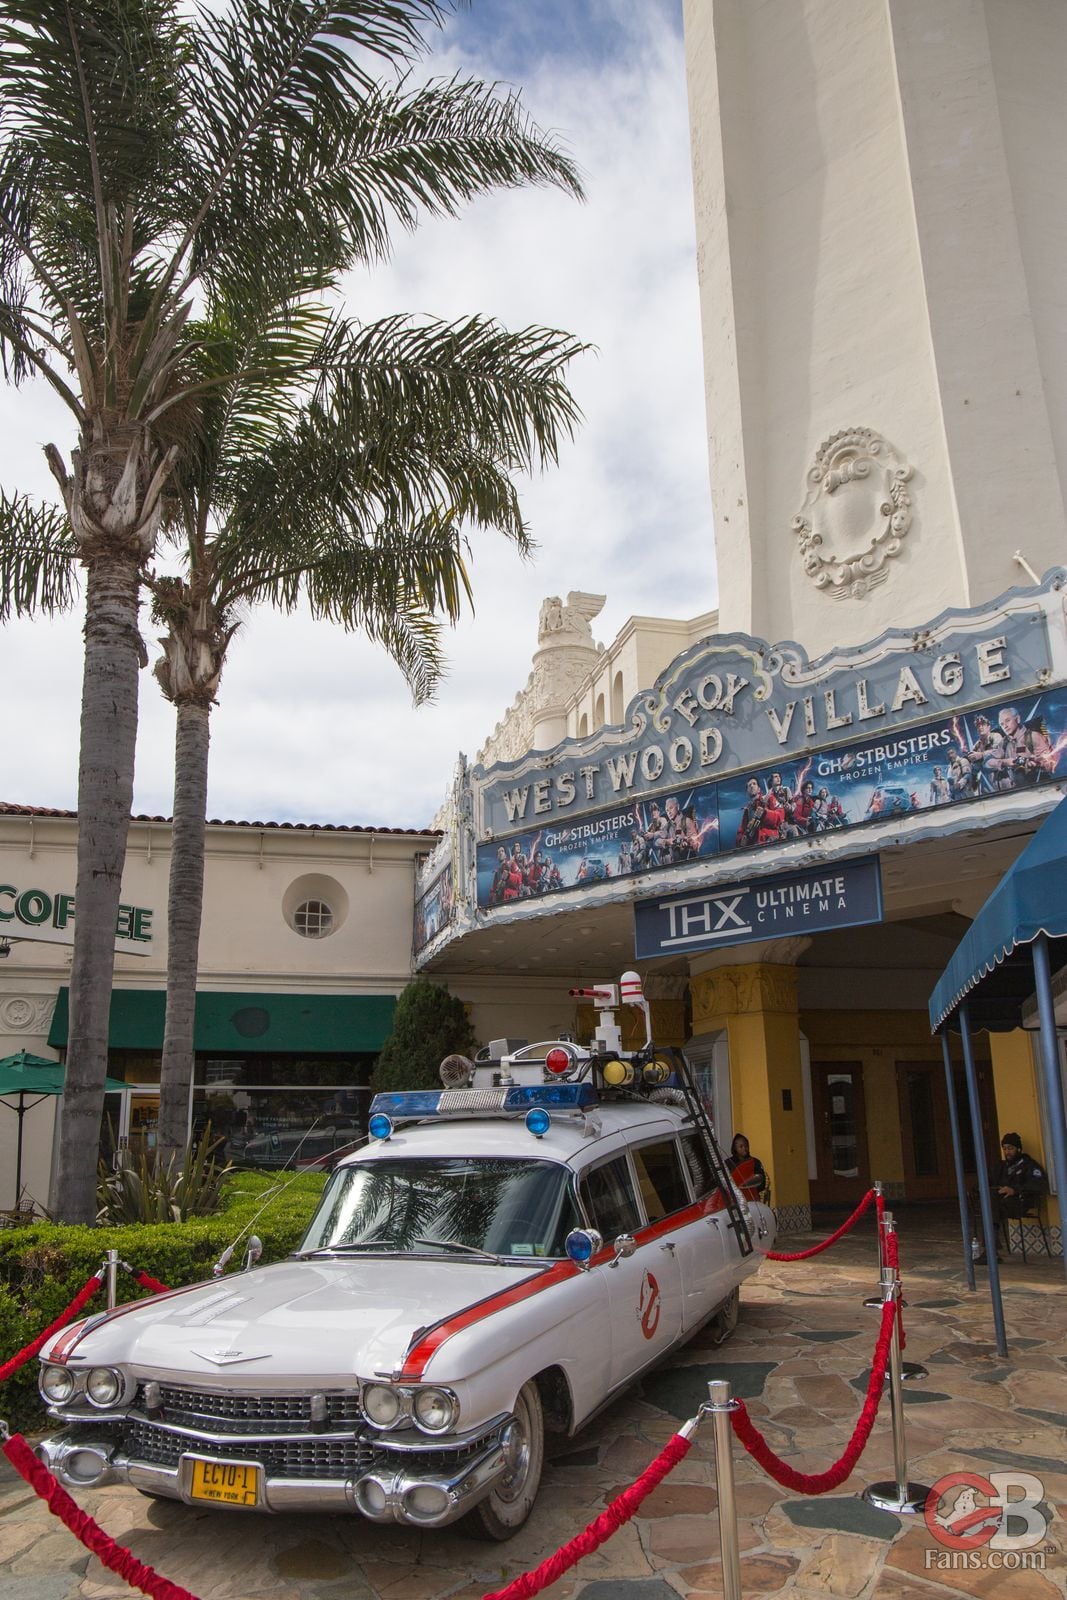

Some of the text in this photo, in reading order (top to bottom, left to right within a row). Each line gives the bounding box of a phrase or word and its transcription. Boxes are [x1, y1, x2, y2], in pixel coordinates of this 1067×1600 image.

[672, 673, 750, 728] FOX
[503, 636, 1012, 822] WESTWOOD VILLAGE
[840, 753, 929, 782] FROZEN EMPIRE
[559, 840, 588, 853] FROZEN
[0, 884, 153, 942] COFEE
[659, 877, 846, 938] THX ULTIMATE
[757, 897, 847, 922] CINEMA
